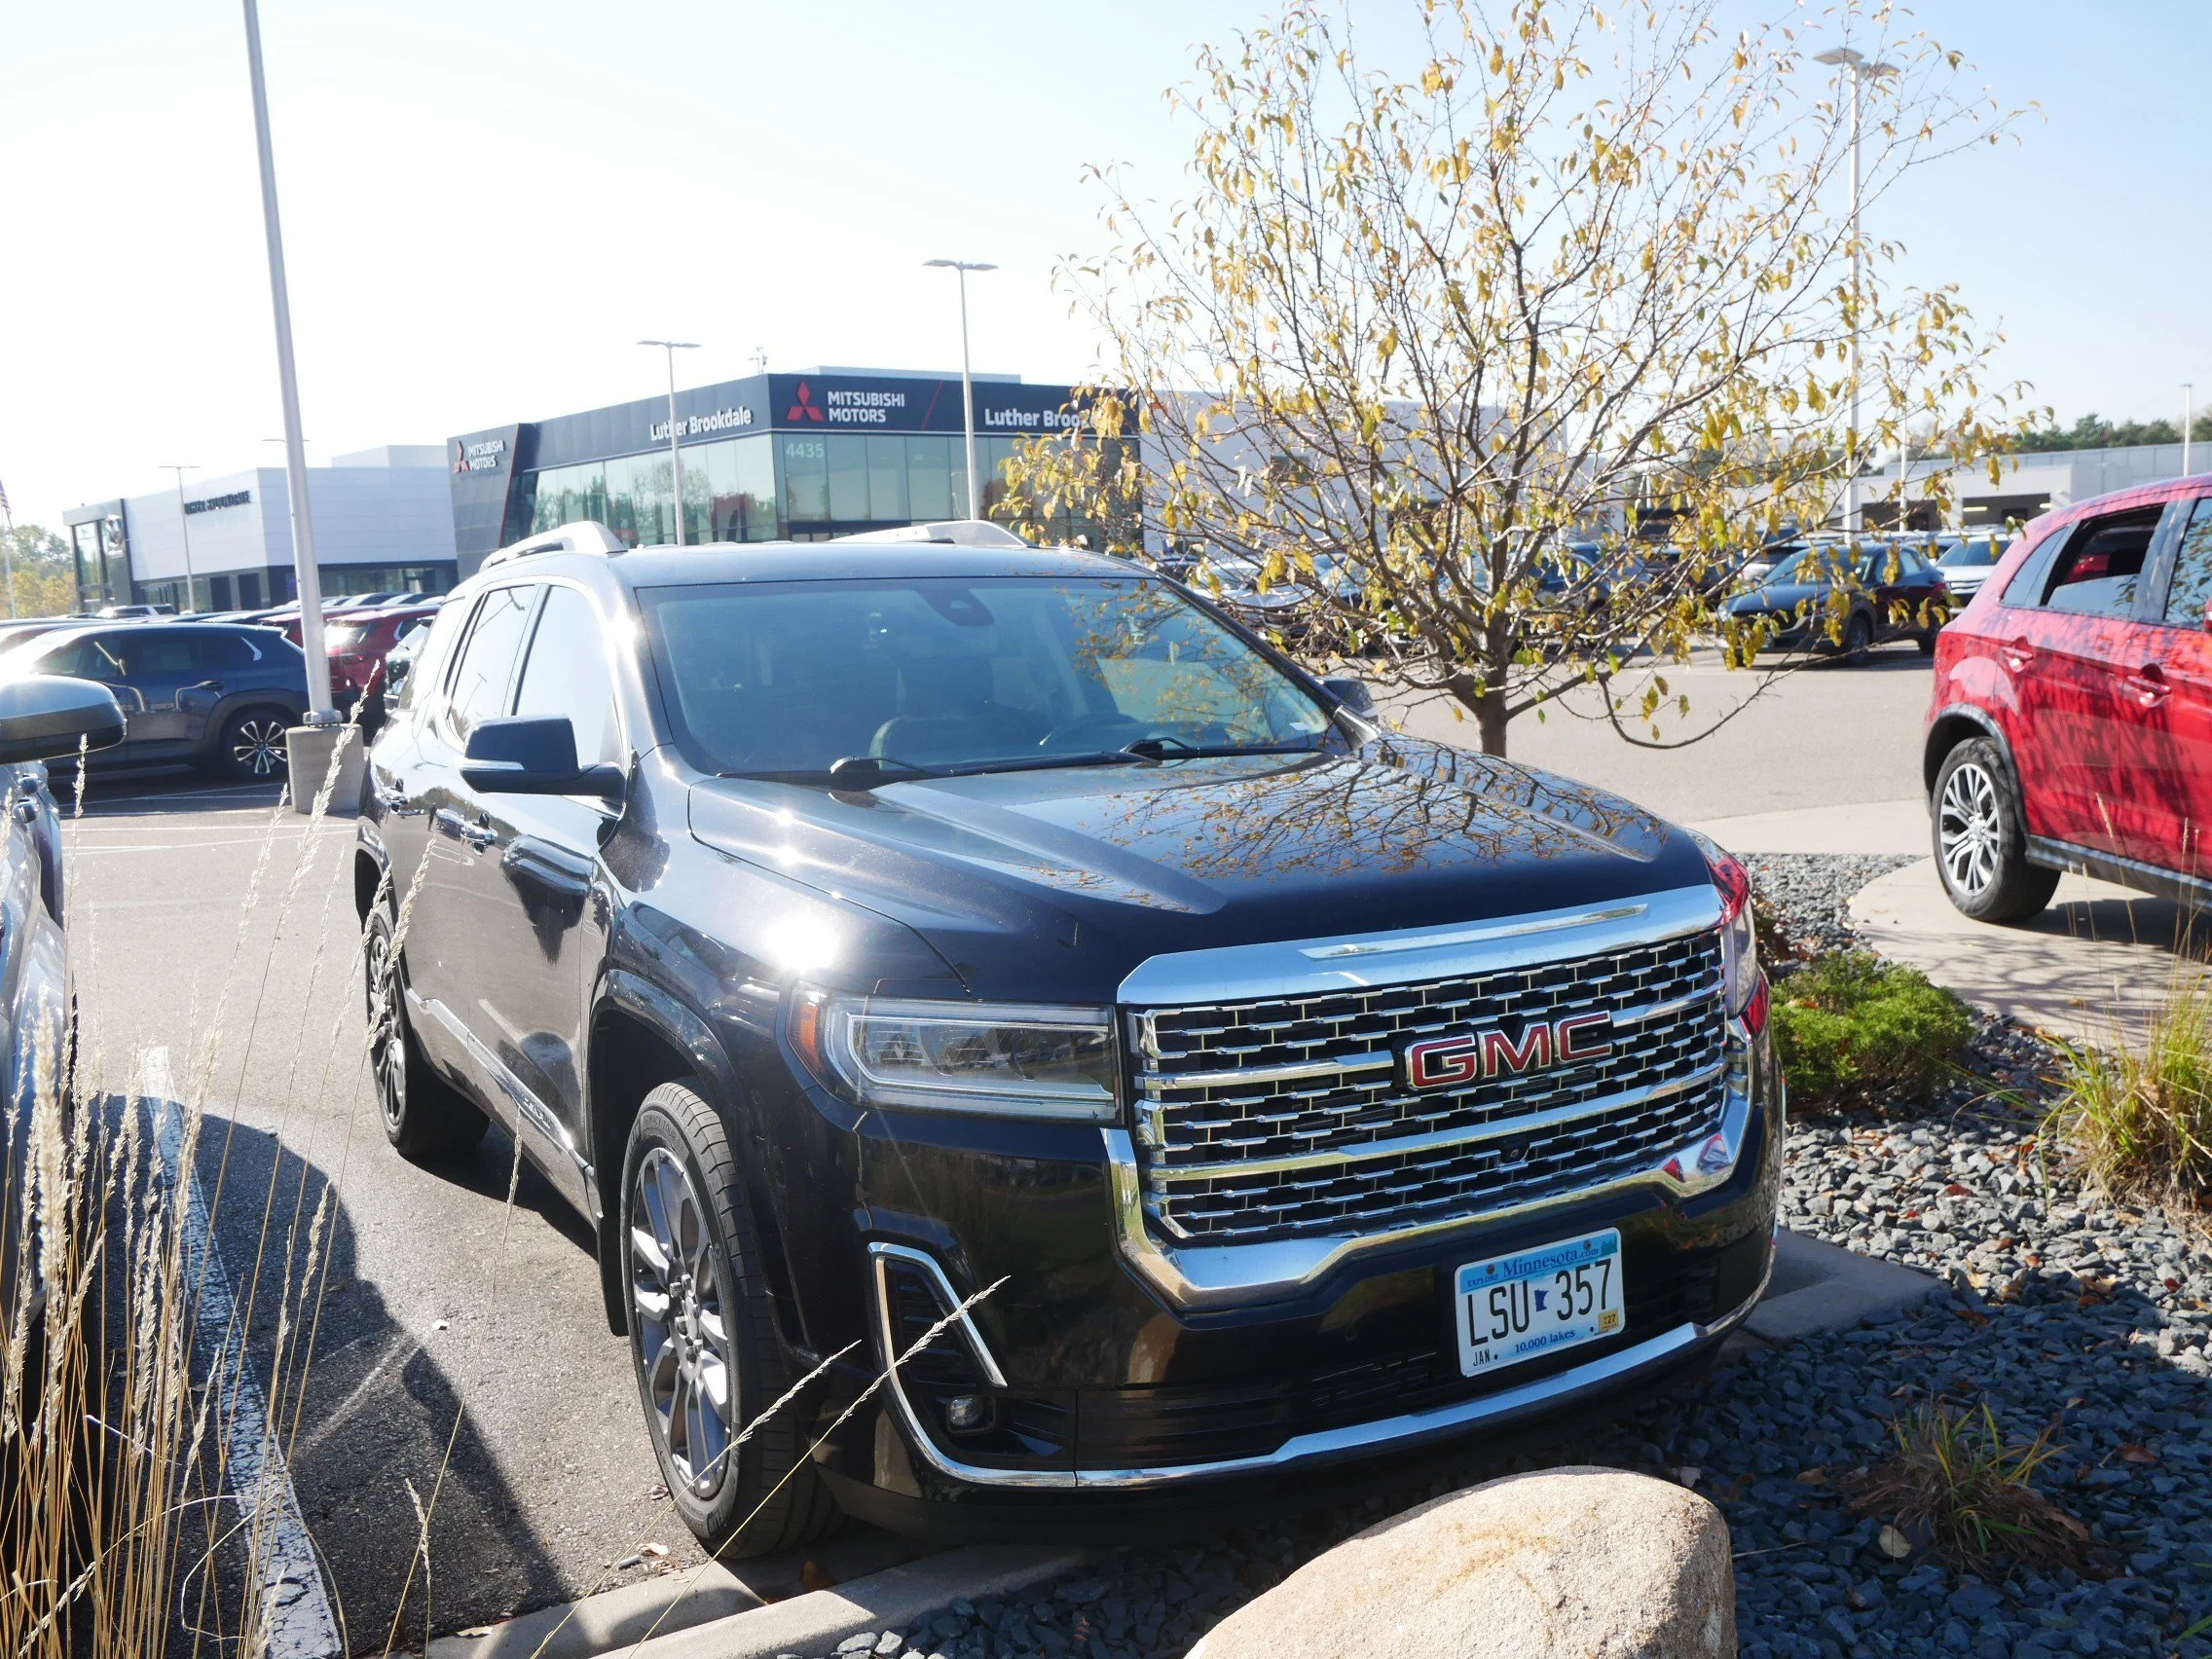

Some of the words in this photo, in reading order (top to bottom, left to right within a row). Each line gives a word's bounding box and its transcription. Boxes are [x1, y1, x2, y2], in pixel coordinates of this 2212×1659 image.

[828, 391, 905, 407] MITSUBISHI
[689, 405, 752, 434] Brookdale
[829, 408, 887, 423] MOTORS
[984, 408, 1040, 426] Luther
[785, 443, 825, 458] 4435
[1405, 1010, 1612, 1089] GMC
[1467, 1273, 1499, 1287] EXPLORE
[1467, 1280, 1530, 1346] LSU
[1555, 1258, 1611, 1321] 357
[1514, 1335, 1547, 1353] 10,000
[1549, 1329, 1575, 1344] lakes
[1473, 1348, 1491, 1367] JAN
